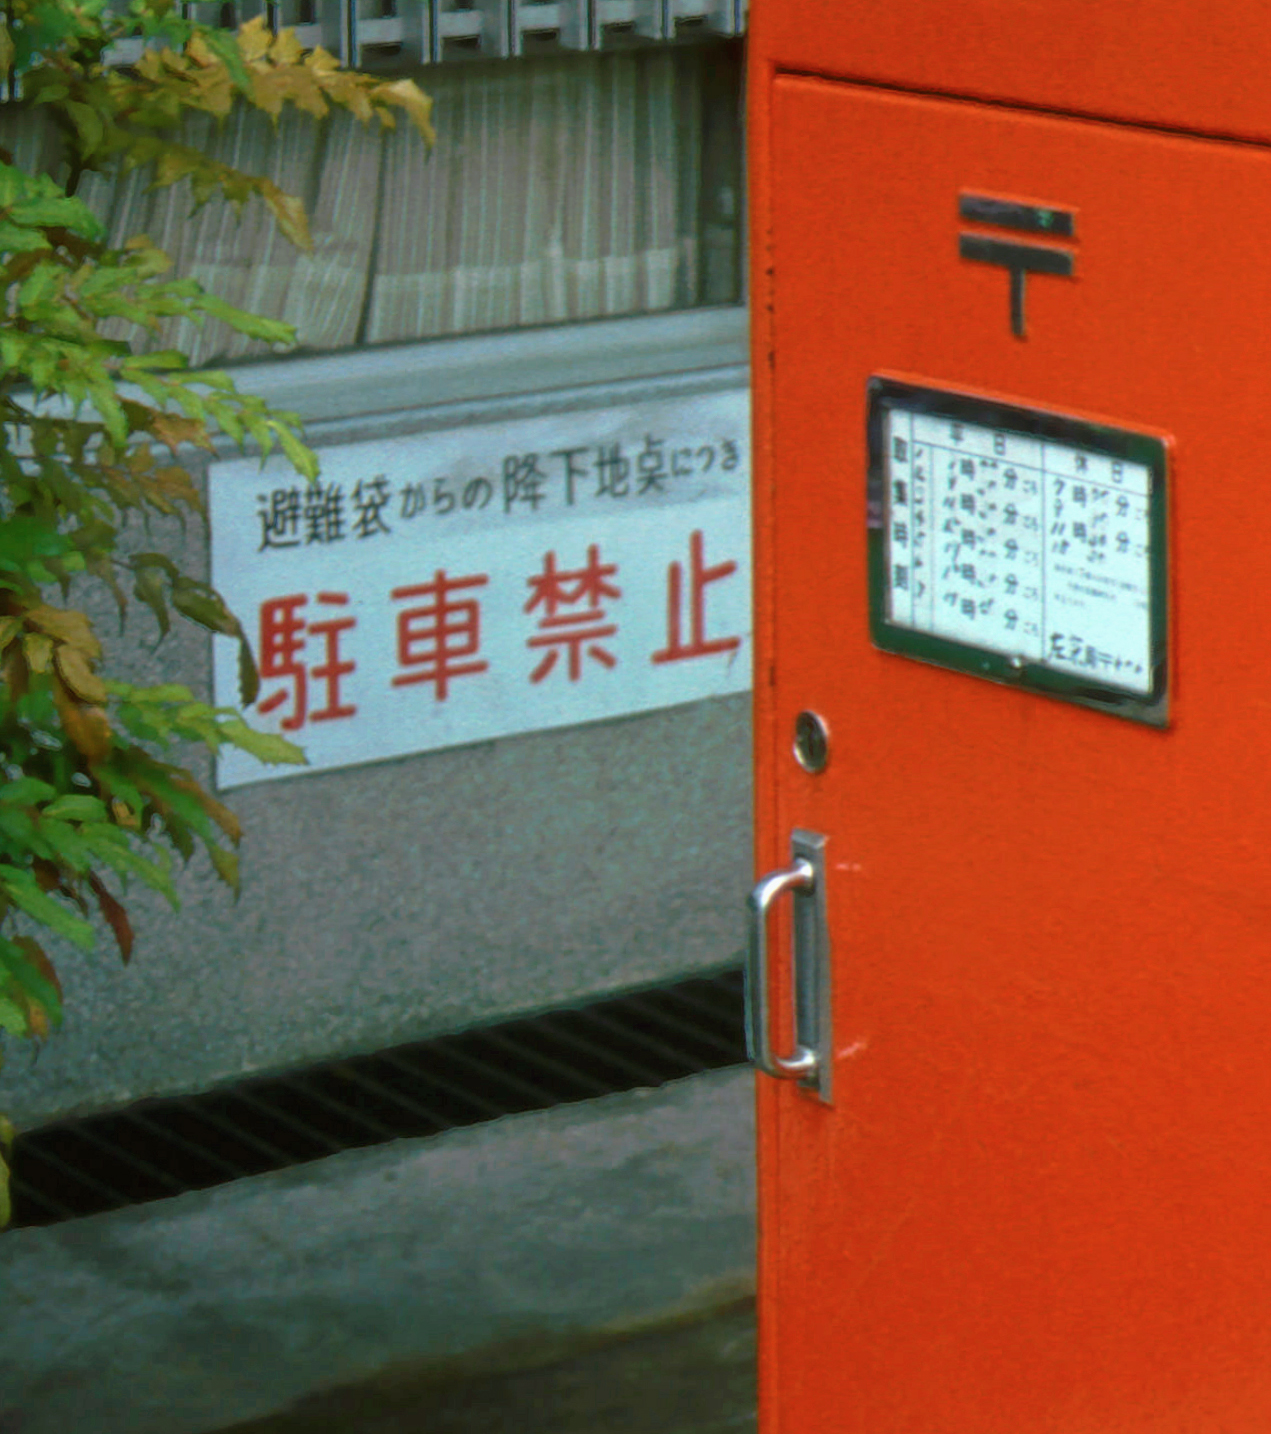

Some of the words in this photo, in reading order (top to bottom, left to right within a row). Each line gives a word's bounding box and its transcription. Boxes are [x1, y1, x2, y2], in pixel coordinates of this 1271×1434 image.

[255, 438, 740, 553] 避難袋からの降下地点につき
[256, 530, 742, 731] 駐車禁止
